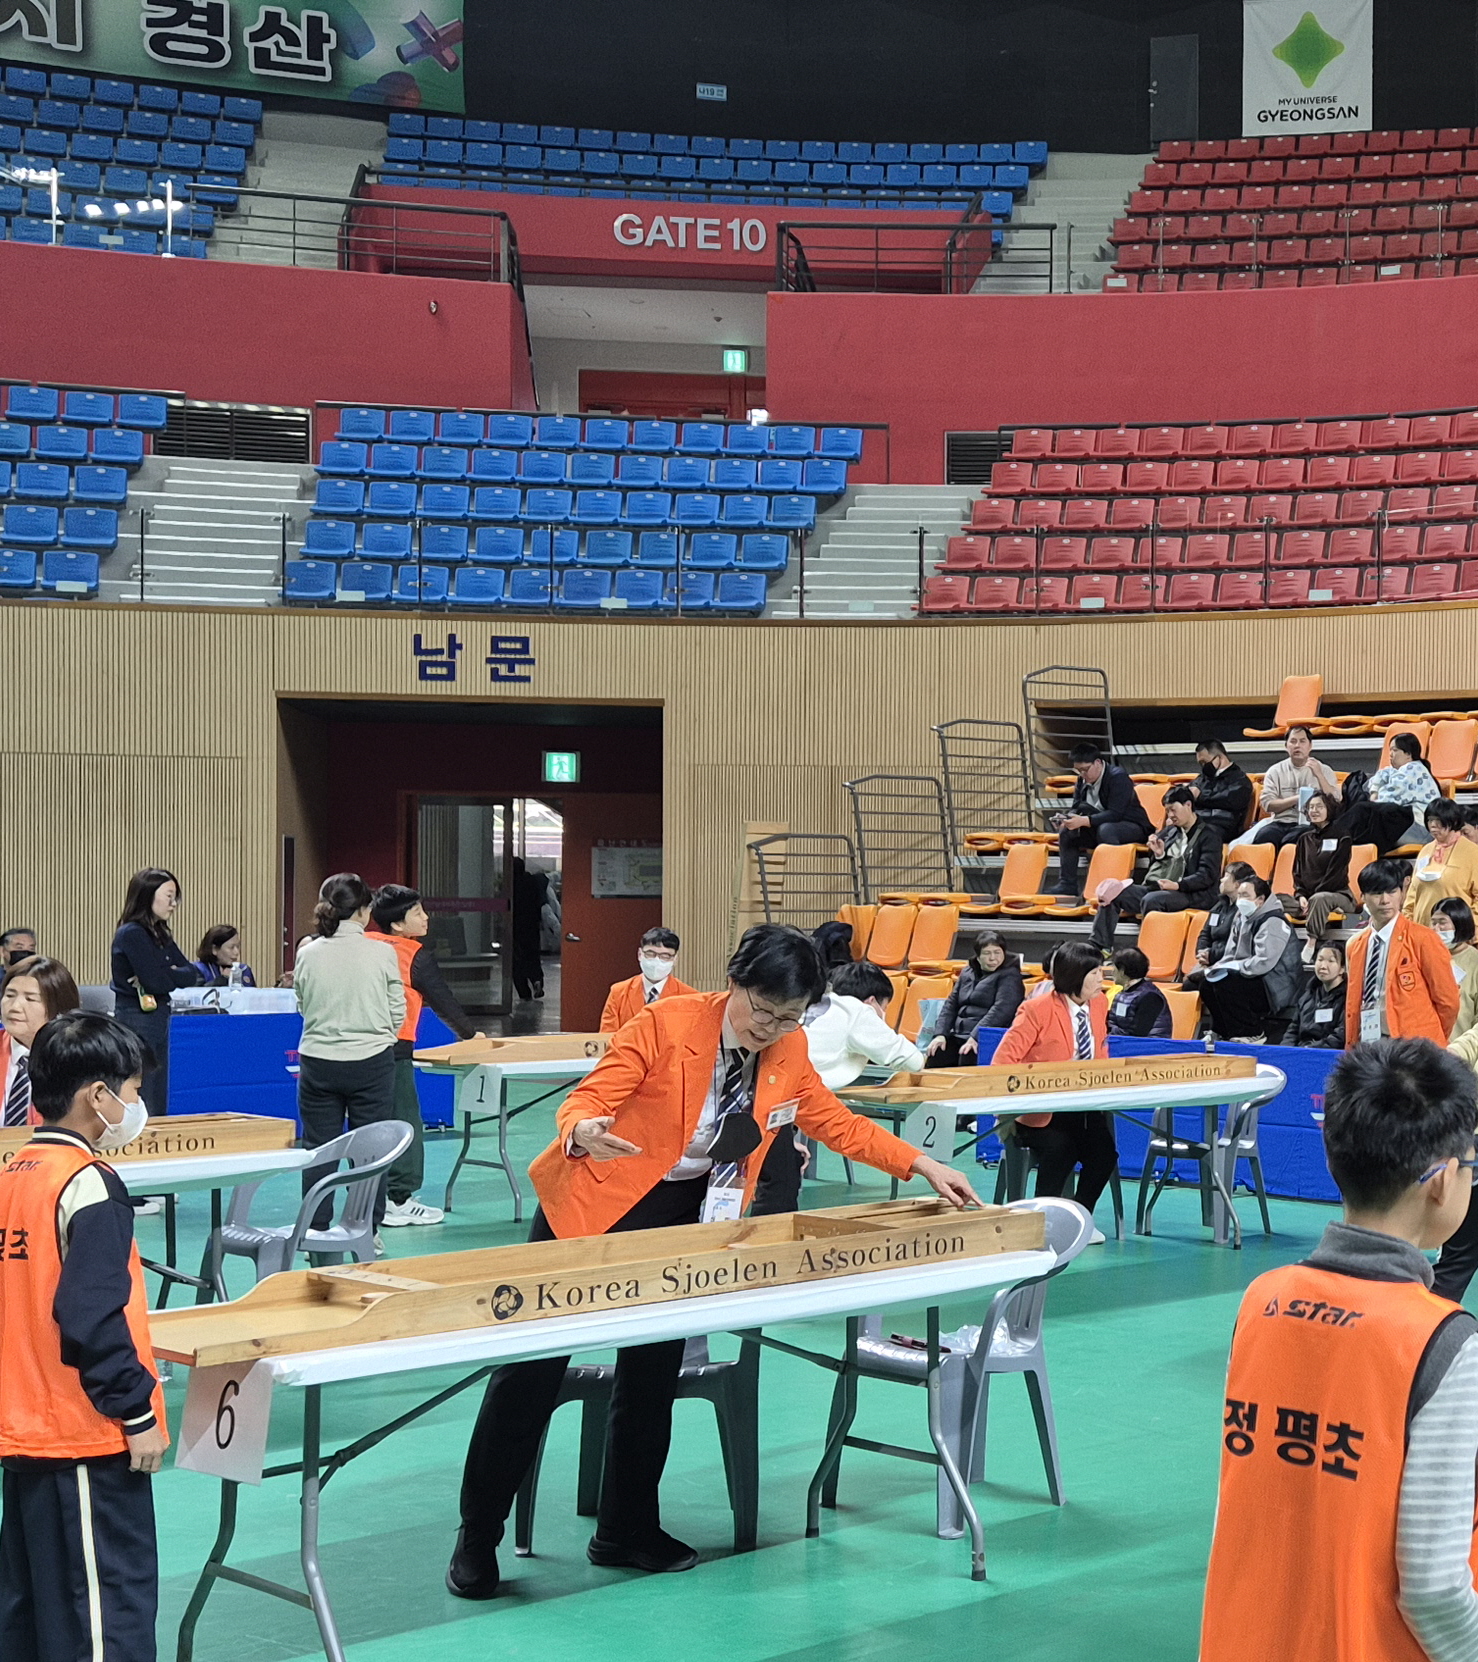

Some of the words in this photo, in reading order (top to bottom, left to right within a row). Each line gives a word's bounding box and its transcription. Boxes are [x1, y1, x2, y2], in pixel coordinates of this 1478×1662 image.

[1257, 105, 1359, 123] GYEONGSAN
[1278, 98, 1292, 106] MY
[1293, 95, 1338, 105] UNIVERSE
[613, 213, 721, 250] GATE
[727, 217, 767, 252] 10
[476, 1074, 485, 1103] 1
[1025, 1075, 1070, 1090] Korea
[1078, 1070, 1132, 1088] Sjoelen
[1140, 1064, 1221, 1082] Association
[923, 1116, 936, 1148] 2
[536, 1276, 641, 1311] Korea
[661, 1257, 778, 1295] Sjoelen
[796, 1234, 966, 1275] Association
[215, 1379, 240, 1450] 6
